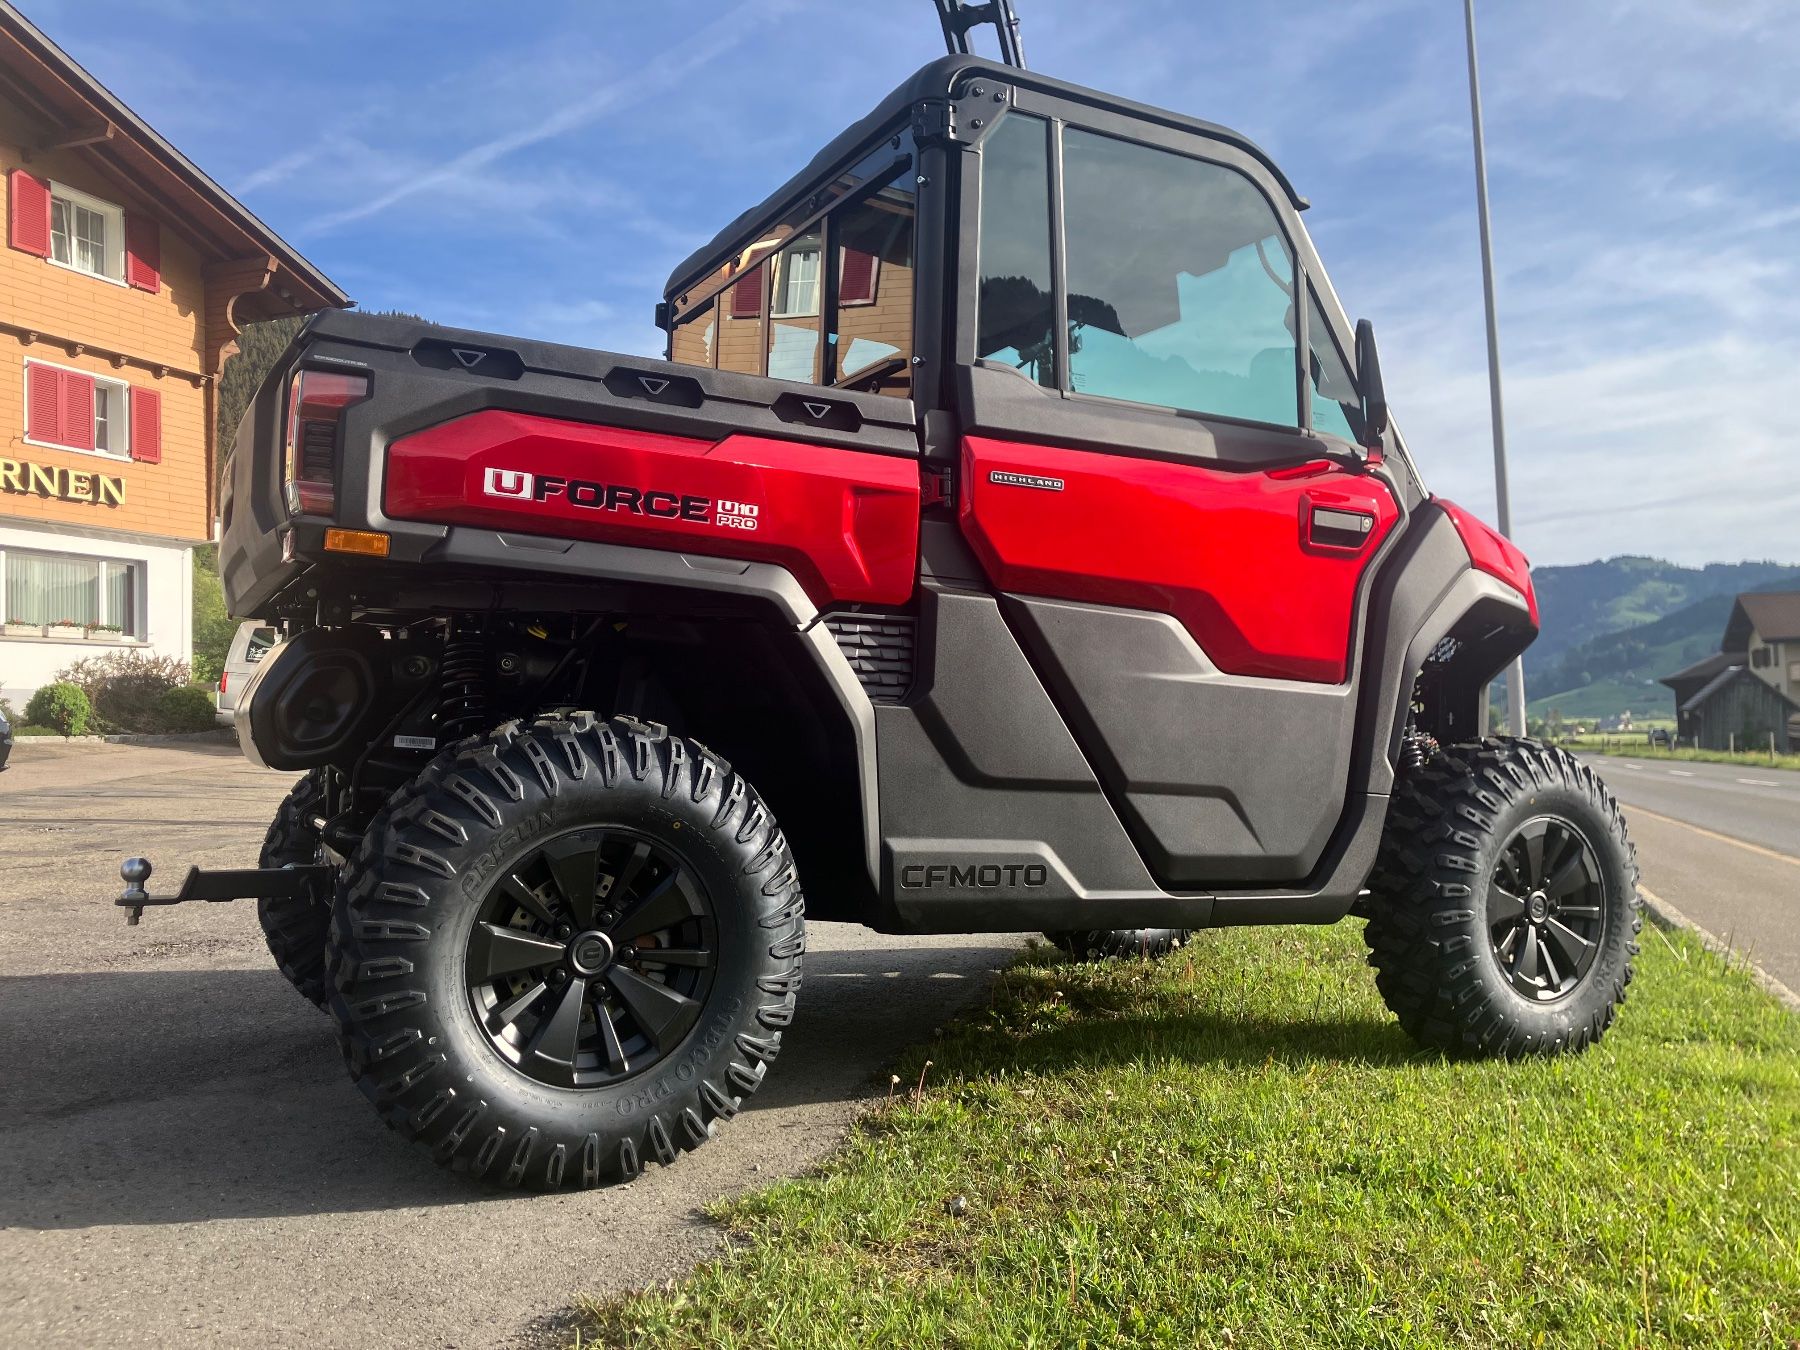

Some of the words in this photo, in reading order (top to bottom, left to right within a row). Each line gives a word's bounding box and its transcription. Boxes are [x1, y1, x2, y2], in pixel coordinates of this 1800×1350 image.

[994, 473, 1062, 488] HIGHLAND
[717, 499, 759, 517] U10
[717, 514, 758, 531] PRO
[900, 864, 1047, 889] CFMOTO
